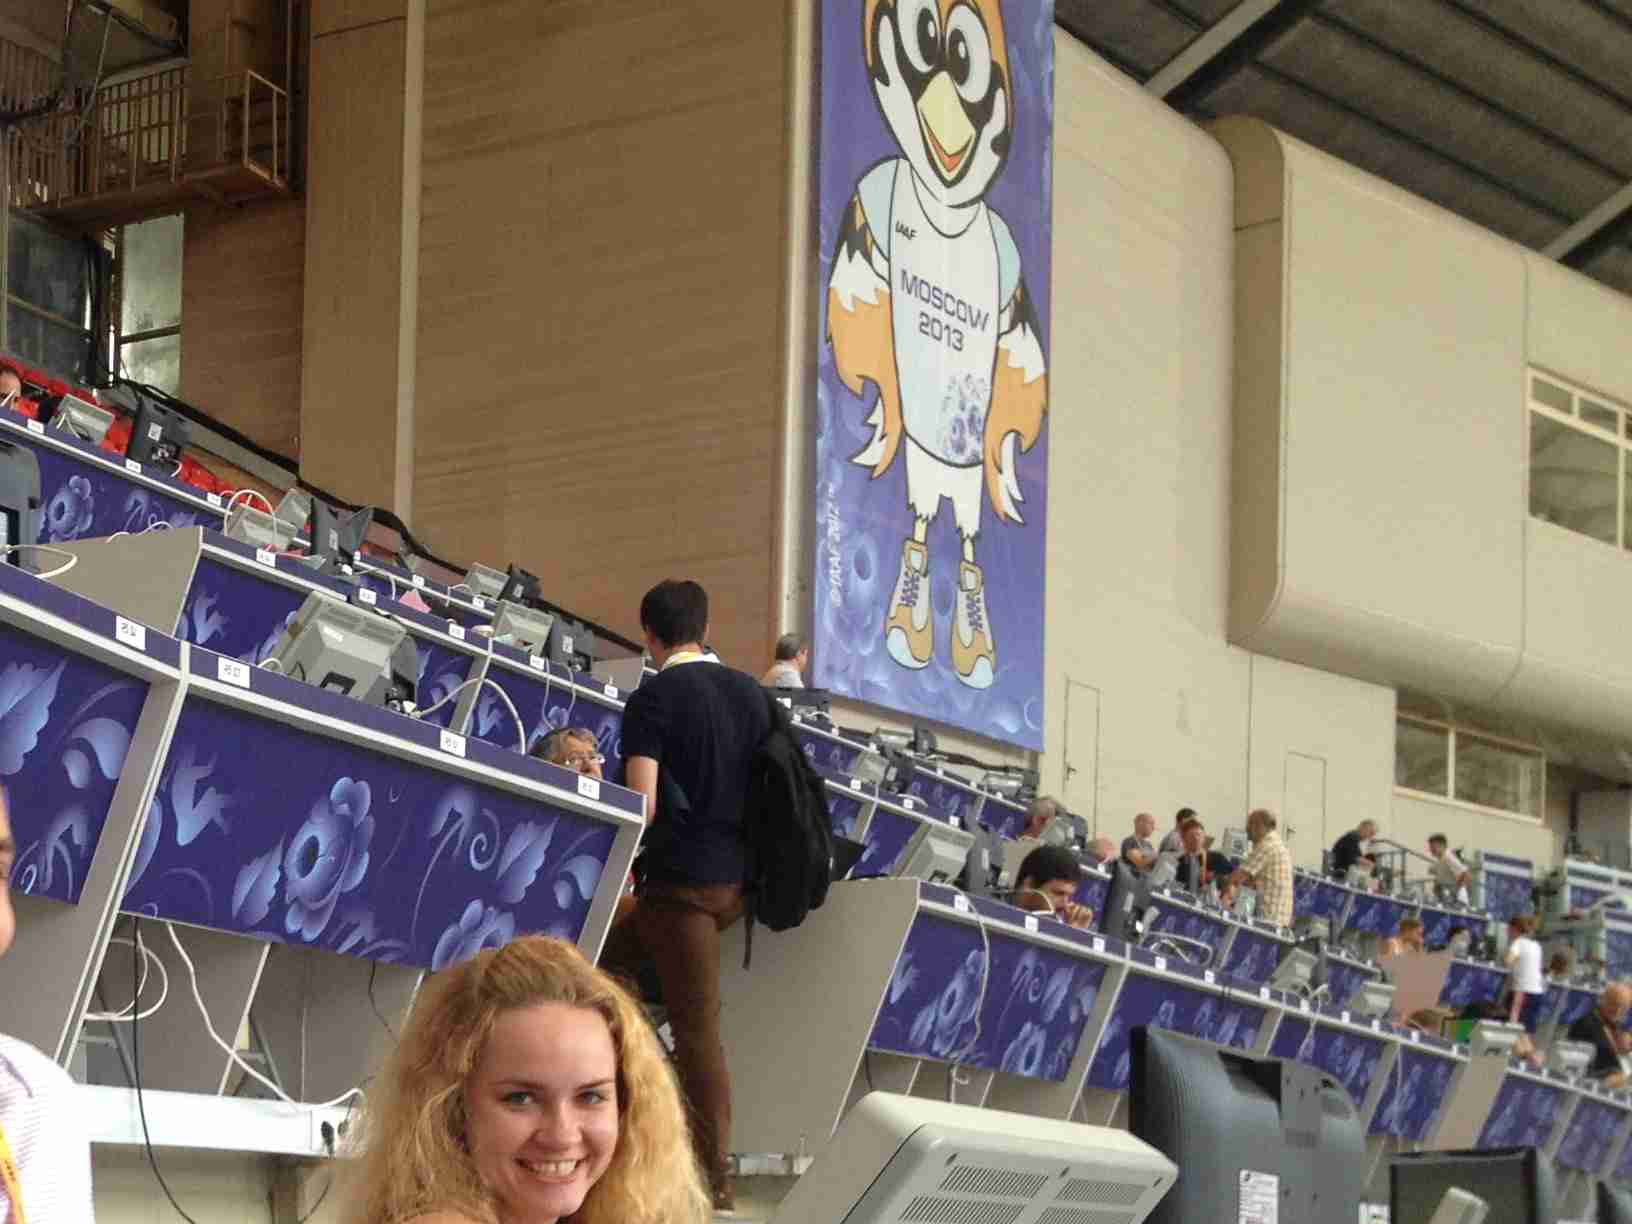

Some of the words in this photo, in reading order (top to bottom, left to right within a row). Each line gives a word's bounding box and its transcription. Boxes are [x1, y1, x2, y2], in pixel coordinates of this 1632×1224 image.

[895, 220, 919, 240] IAAF
[900, 267, 990, 332] MOSCOW
[919, 311, 965, 352] 2013
